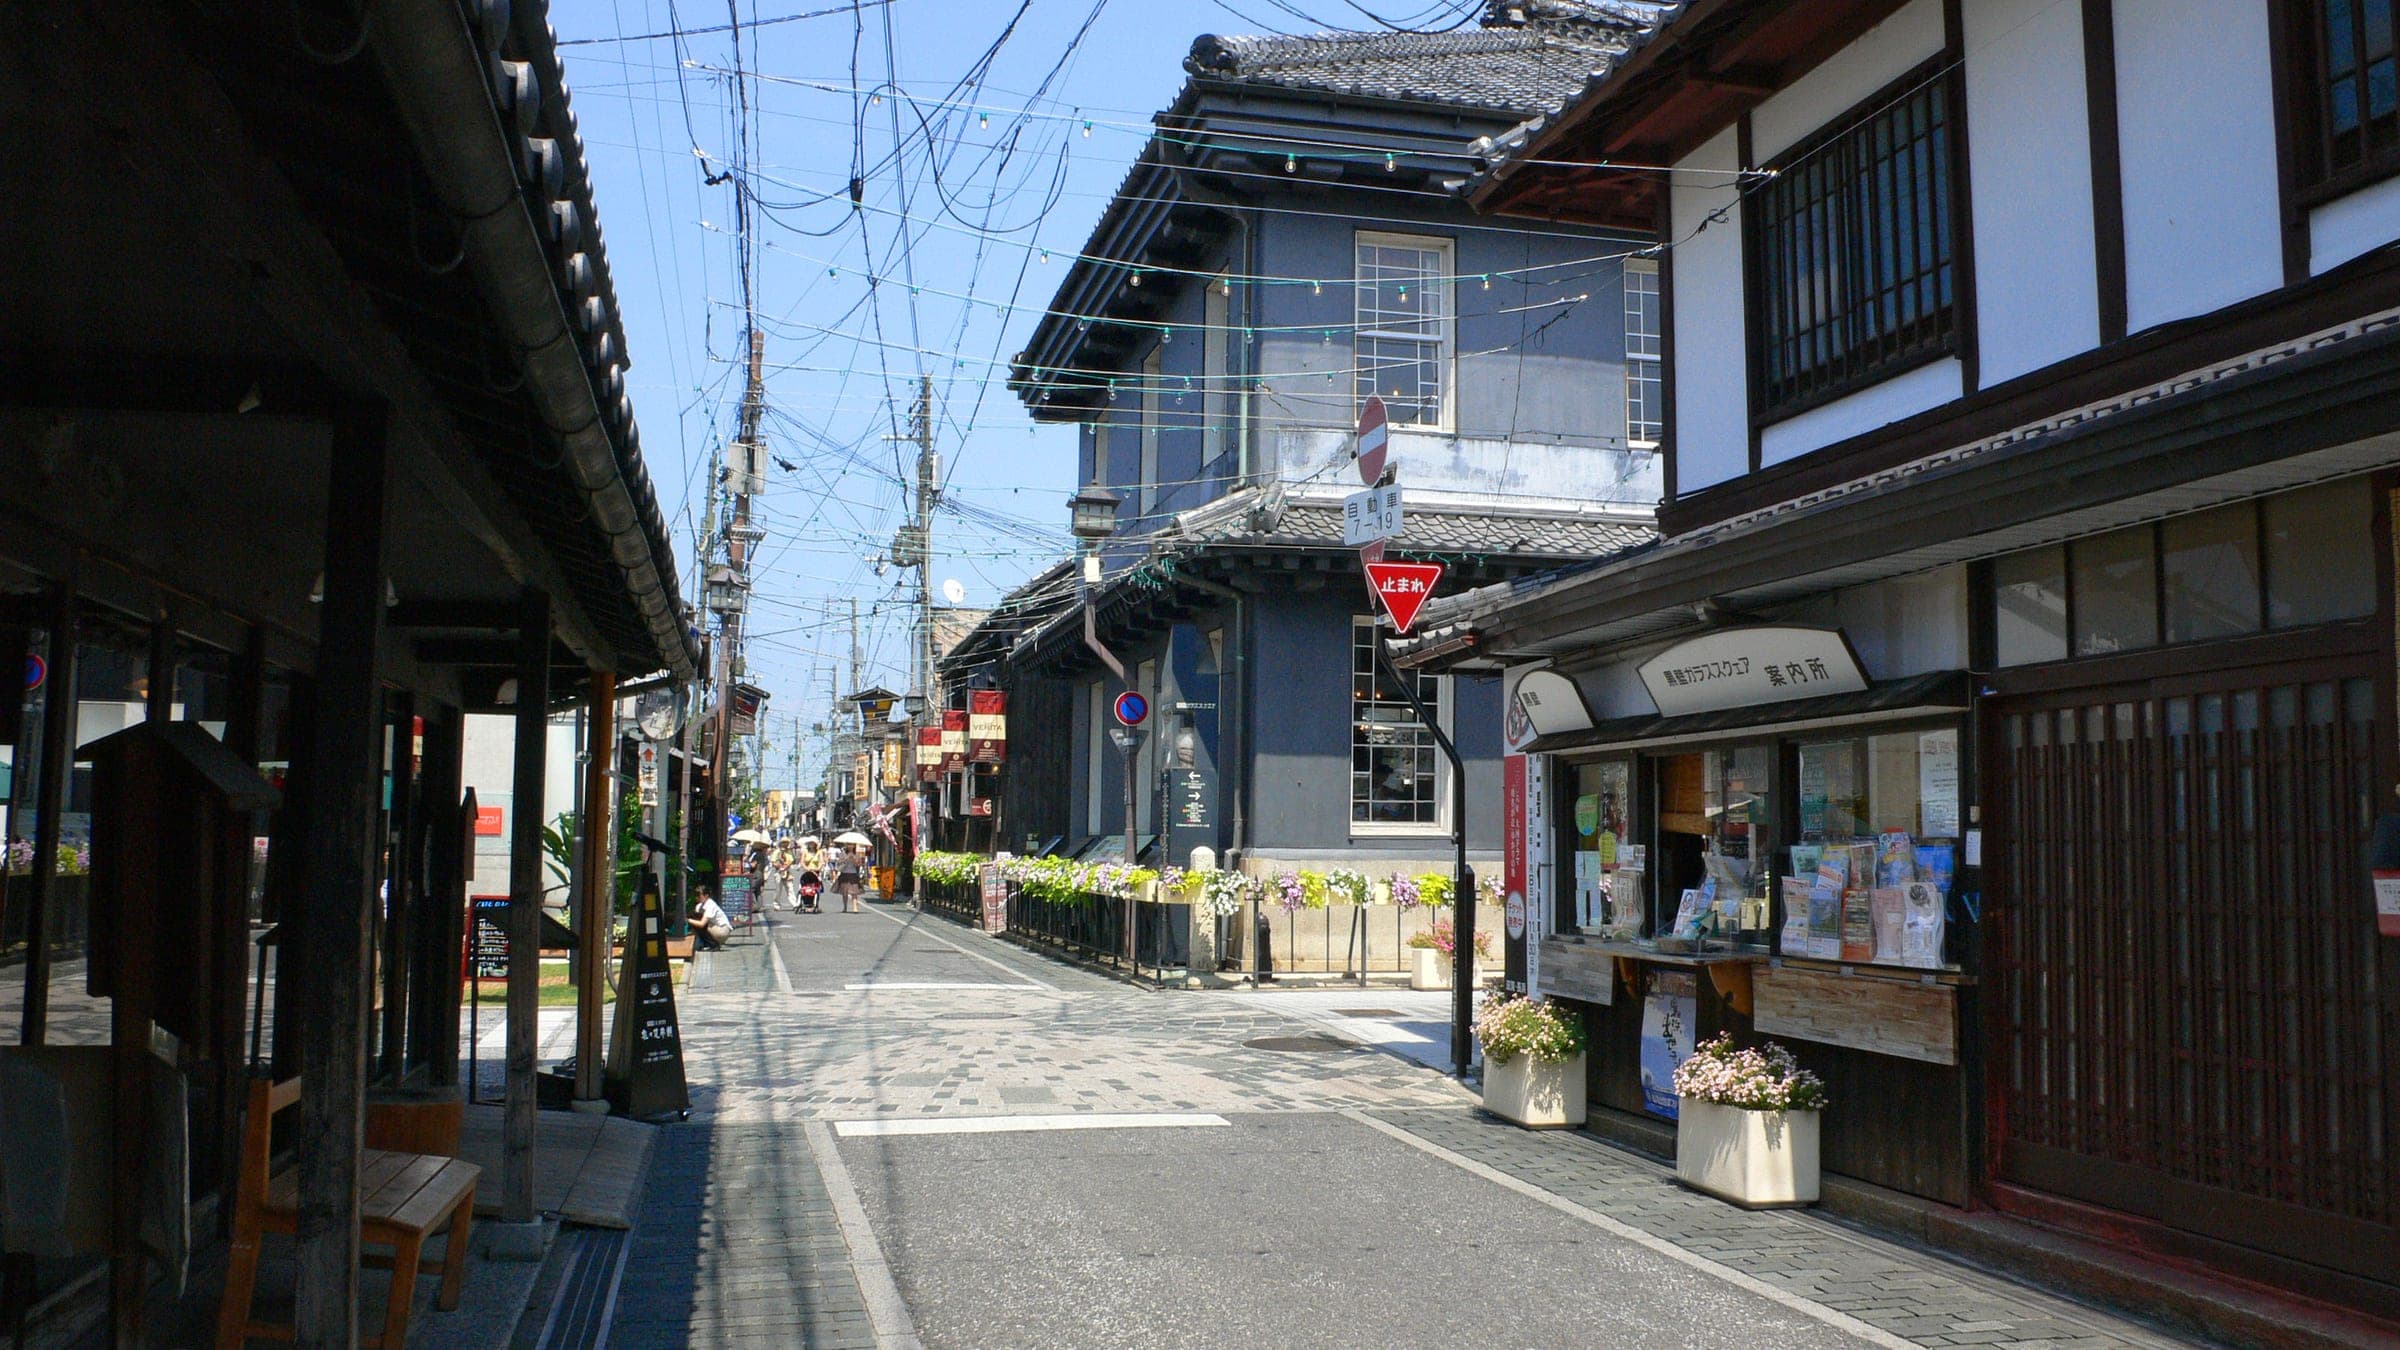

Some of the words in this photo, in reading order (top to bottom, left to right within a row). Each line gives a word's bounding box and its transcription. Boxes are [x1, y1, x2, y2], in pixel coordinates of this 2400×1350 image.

[1347, 491, 1398, 519] 自動車
[1380, 576, 1426, 595] 止まれ
[1763, 656, 1830, 688] 案内所
